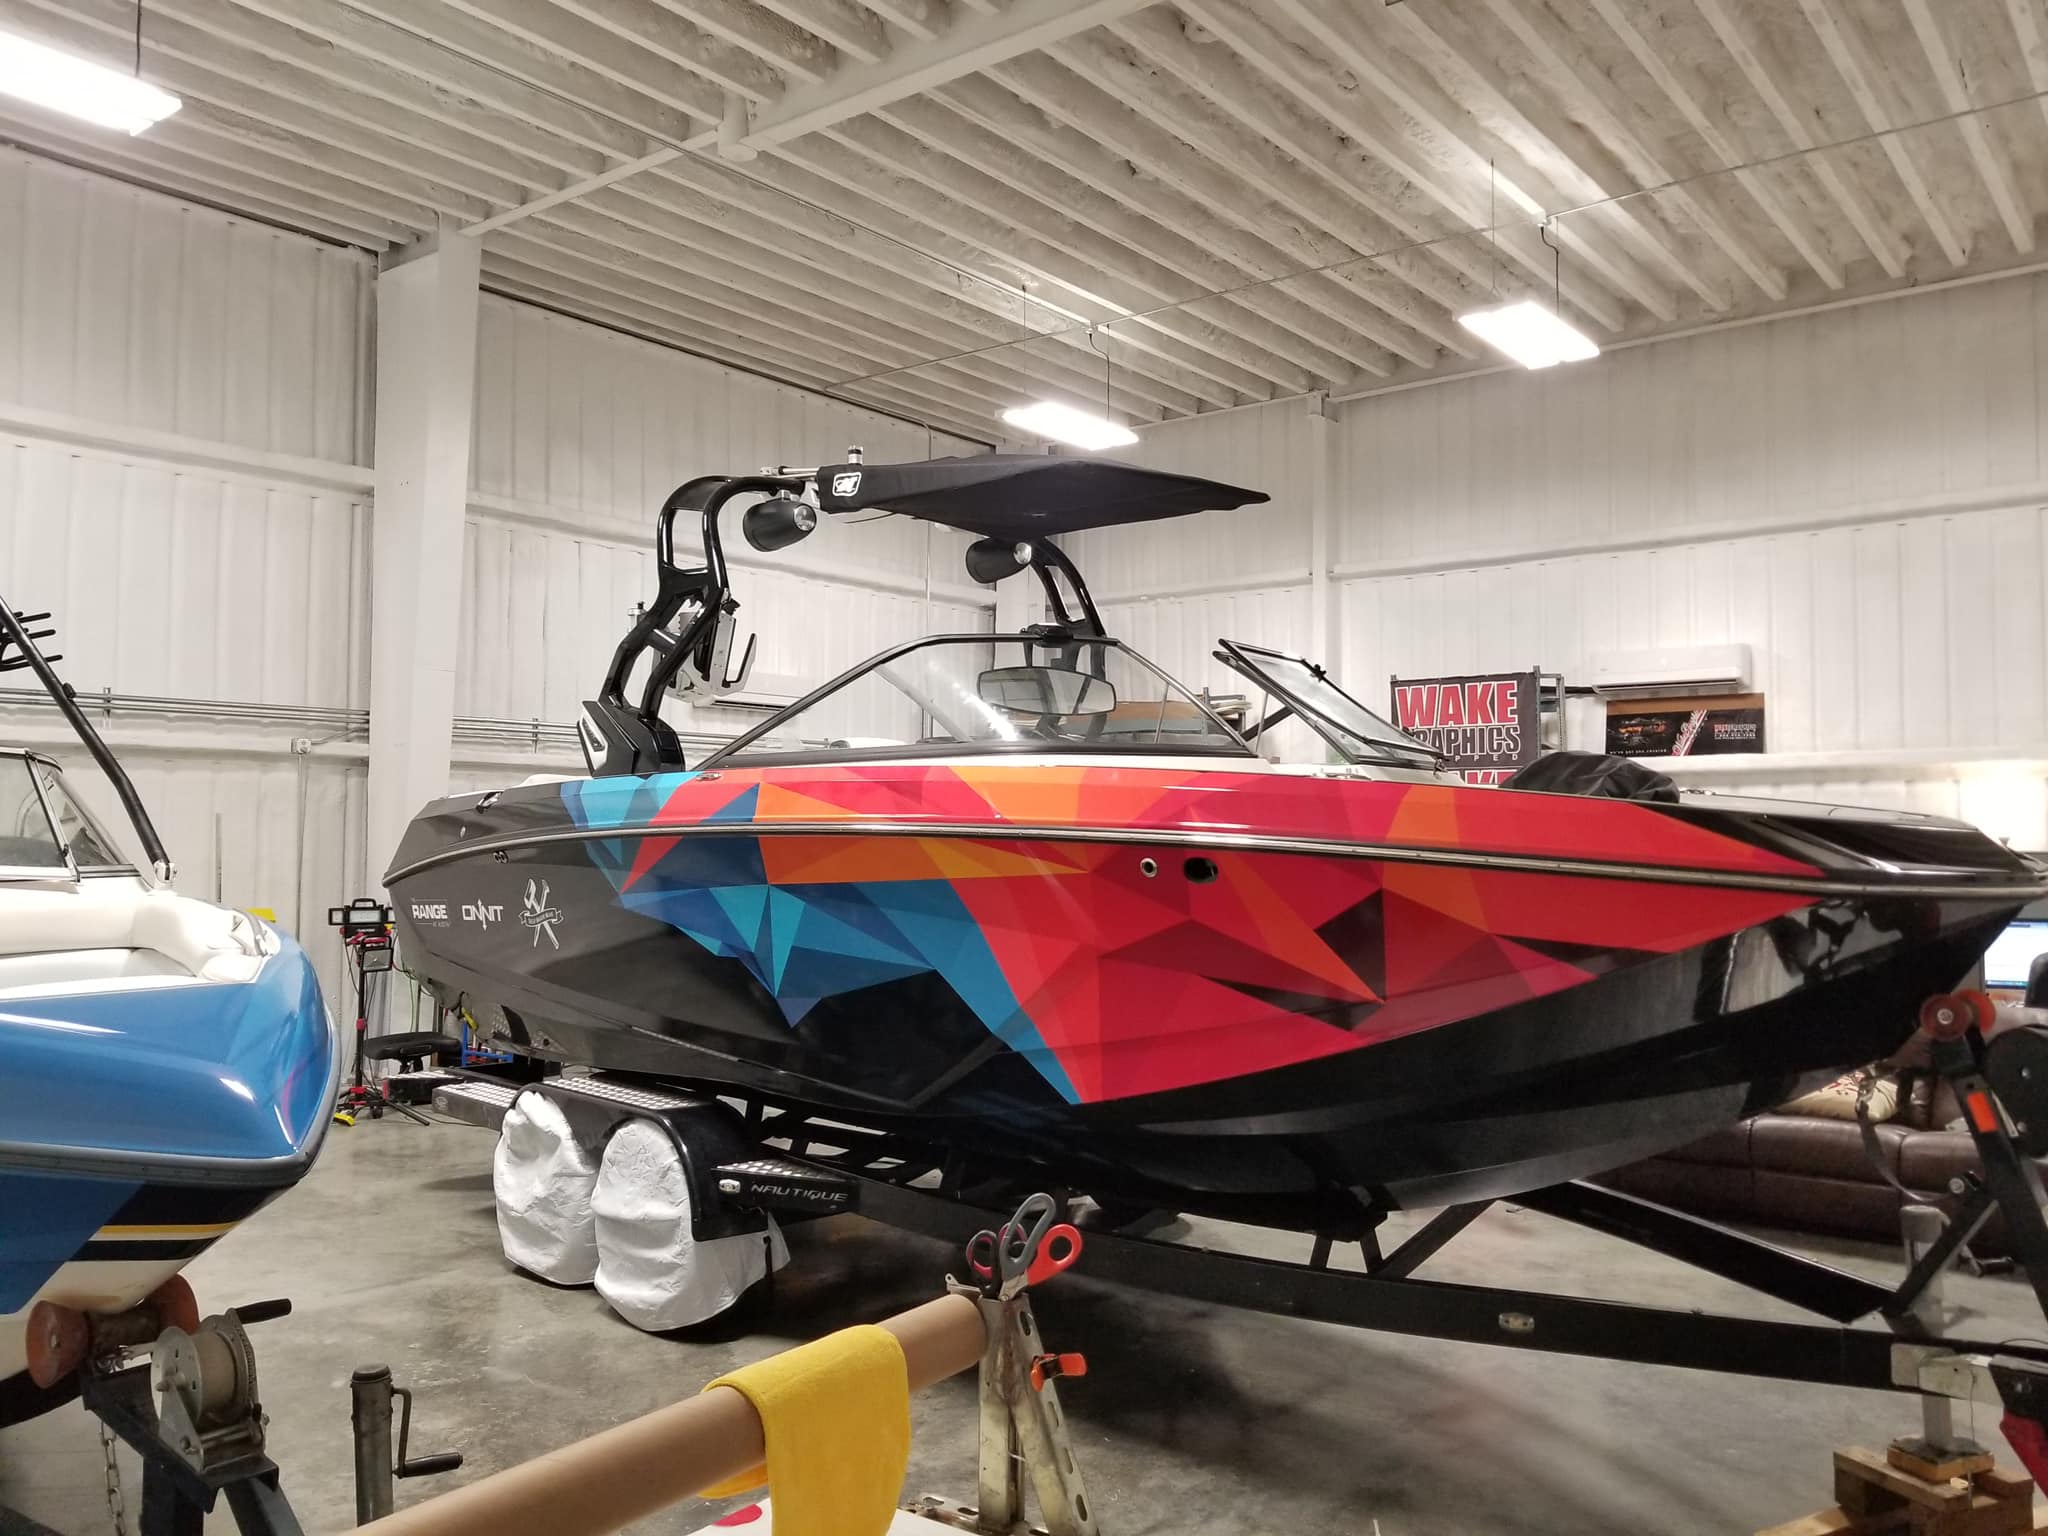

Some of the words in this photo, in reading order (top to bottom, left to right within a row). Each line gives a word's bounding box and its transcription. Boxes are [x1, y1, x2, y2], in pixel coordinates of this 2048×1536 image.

[1395, 680, 1518, 729] WAKE
[1411, 725, 1521, 756] RAPHICS
[411, 904, 448, 920] RANGE
[462, 899, 503, 930] ONNIT
[751, 1184, 848, 1201] NAUTIQUE
